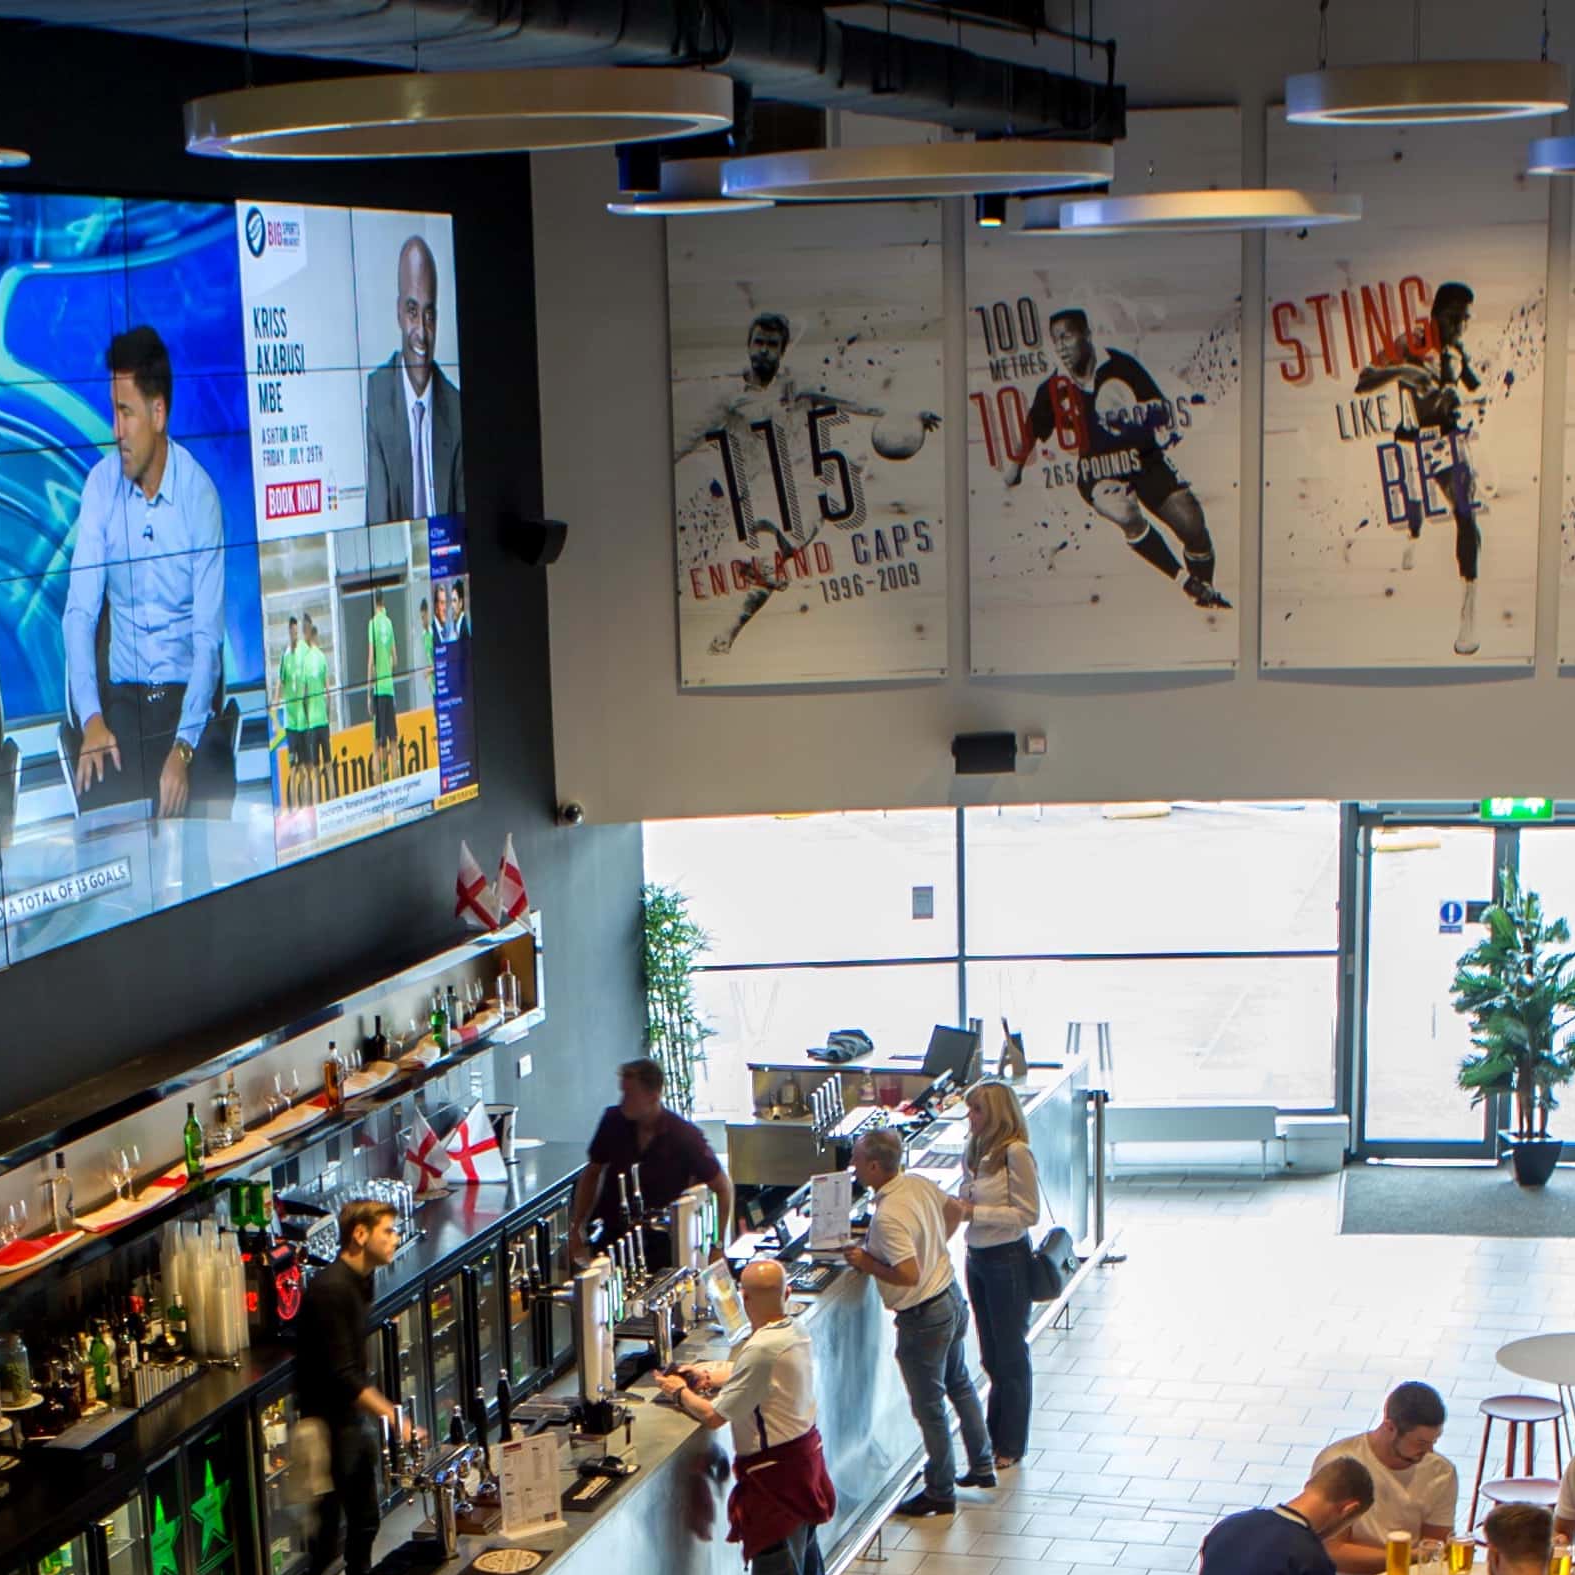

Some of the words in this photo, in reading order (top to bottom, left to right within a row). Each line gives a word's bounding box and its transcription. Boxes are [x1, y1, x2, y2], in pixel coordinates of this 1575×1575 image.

[268, 220, 282, 247] BIG
[253, 307, 288, 339] KRISS
[975, 296, 1041, 356] 100
[1272, 275, 1441, 385] STING
[257, 343, 306, 377] AKABUSI
[989, 351, 1049, 382] METRES
[258, 381, 284, 414] MBE
[1336, 394, 1392, 440] LIKE
[1398, 379, 1419, 433] A
[291, 424, 309, 442] GATE
[705, 405, 865, 549] 115
[1042, 461, 1075, 489] 265
[1078, 448, 1141, 481] POUNDS
[1377, 427, 1482, 525] BEE
[268, 486, 296, 517] BOOK
[296, 482, 320, 513] NOW
[851, 520, 934, 566] CAPS
[690, 541, 835, 601] ENGLAND
[819, 562, 922, 604] 1996-2009
[8, 899, 17, 917] A
[17, 888, 57, 911] TOTAL
[58, 882, 74, 900] OF
[76, 877, 89, 894] 13
[89, 867, 127, 890] GOALS
